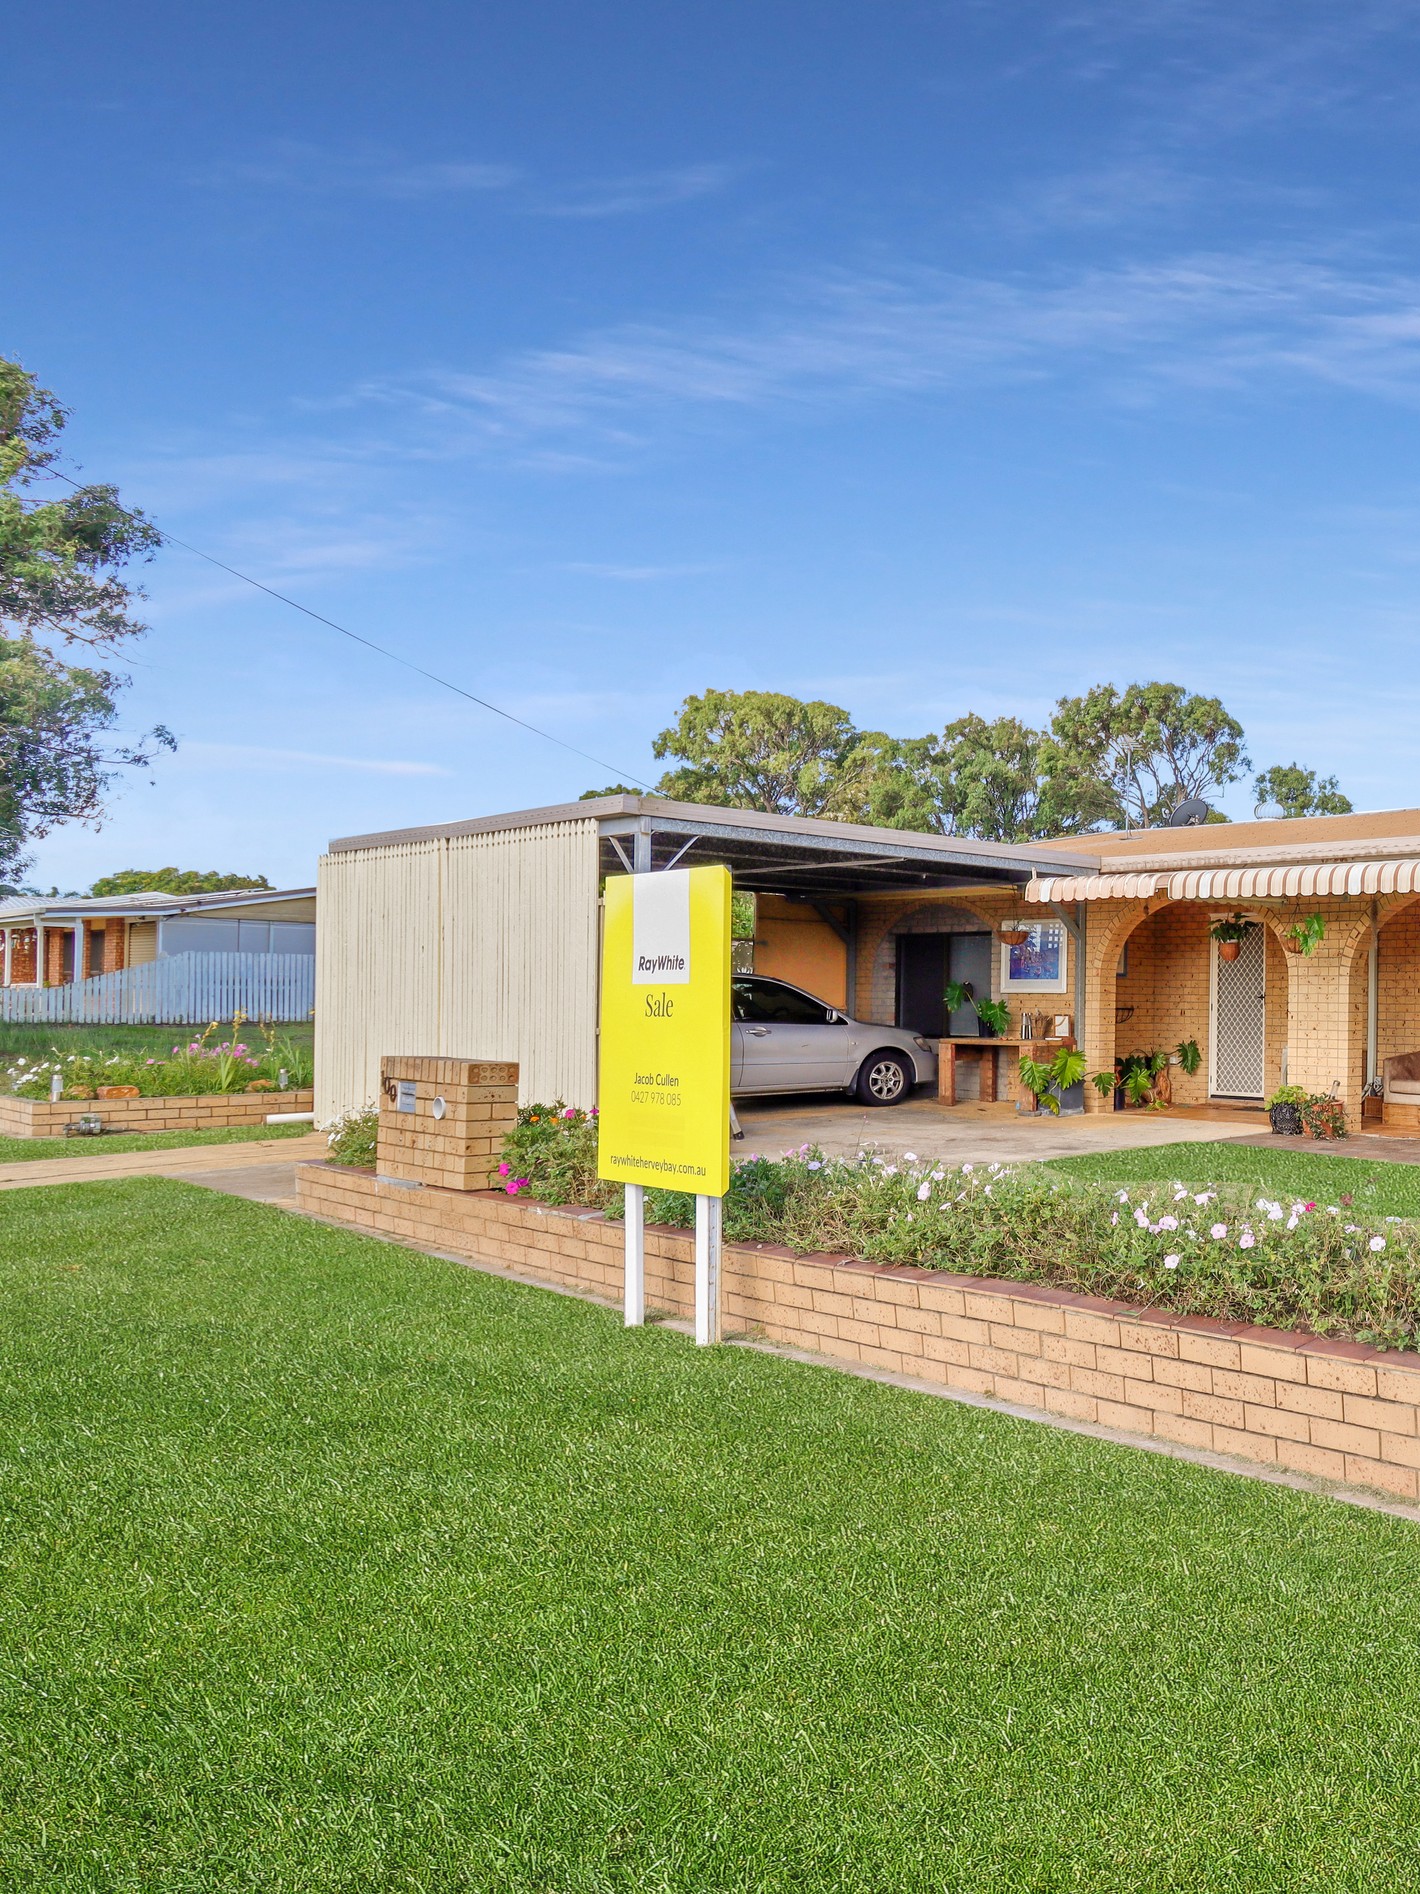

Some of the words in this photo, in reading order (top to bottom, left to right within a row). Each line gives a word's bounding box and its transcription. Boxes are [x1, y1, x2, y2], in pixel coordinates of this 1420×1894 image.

[638, 955, 685, 974] RayWhite
[645, 992, 674, 1018] Sale
[634, 1072, 655, 1086] Jacob
[655, 1073, 679, 1087] Cullen
[631, 1090, 649, 1104] 0427
[651, 1092, 665, 1105] 978
[666, 1093, 682, 1106] 085
[610, 1154, 706, 1177] raywhiteherveybay.com.au
